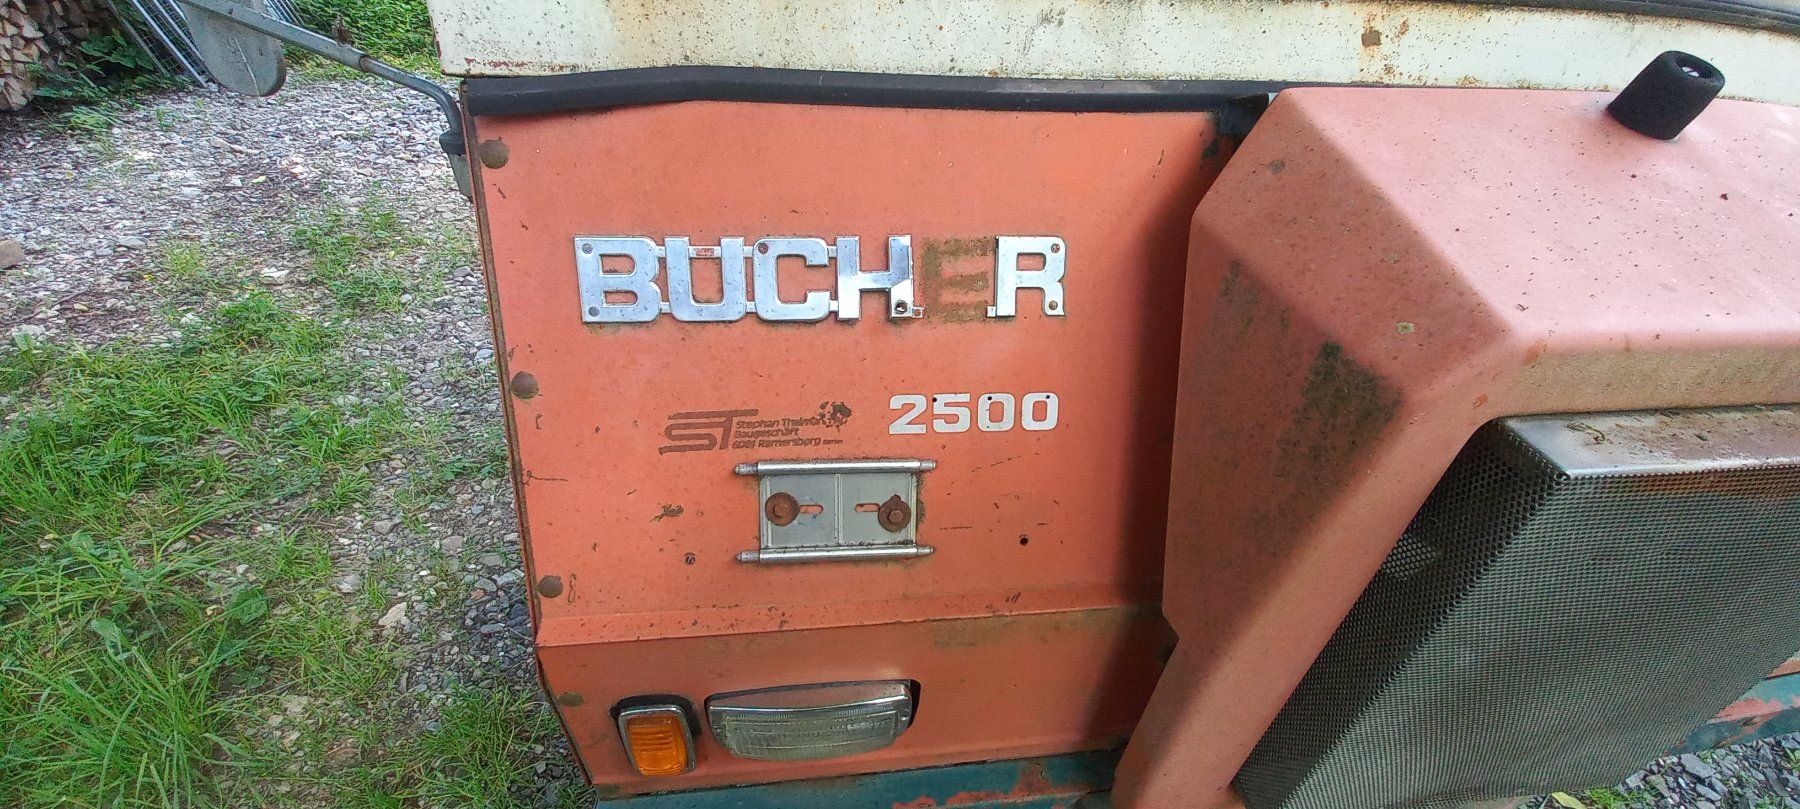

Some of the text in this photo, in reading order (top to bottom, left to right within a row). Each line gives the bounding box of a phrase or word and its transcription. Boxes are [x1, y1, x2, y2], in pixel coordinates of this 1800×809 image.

[574, 235, 1066, 323] BUCHER
[736, 419, 780, 430] Stephan
[888, 392, 1059, 435] 2500
[757, 437, 821, 448] Ramersberg
